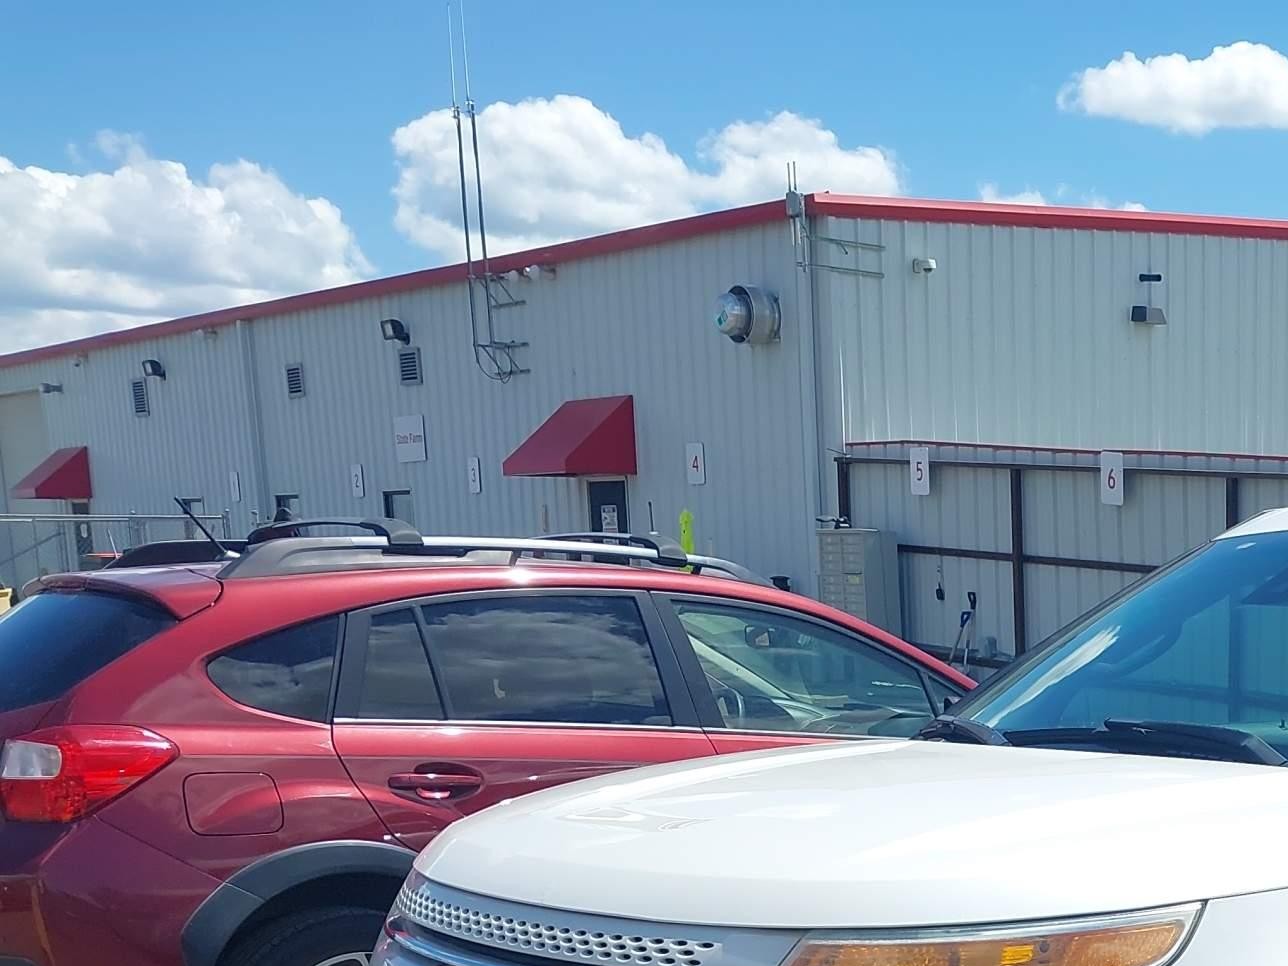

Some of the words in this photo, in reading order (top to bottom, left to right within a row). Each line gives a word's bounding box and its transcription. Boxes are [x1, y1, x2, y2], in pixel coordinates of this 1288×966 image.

[396, 434, 409, 445] State
[408, 432, 423, 444] Farm
[692, 455, 699, 472] 4
[917, 461, 924, 482] 5
[353, 473, 360, 489] 2
[471, 468, 477, 482] 3
[1107, 467, 1116, 490] 6
